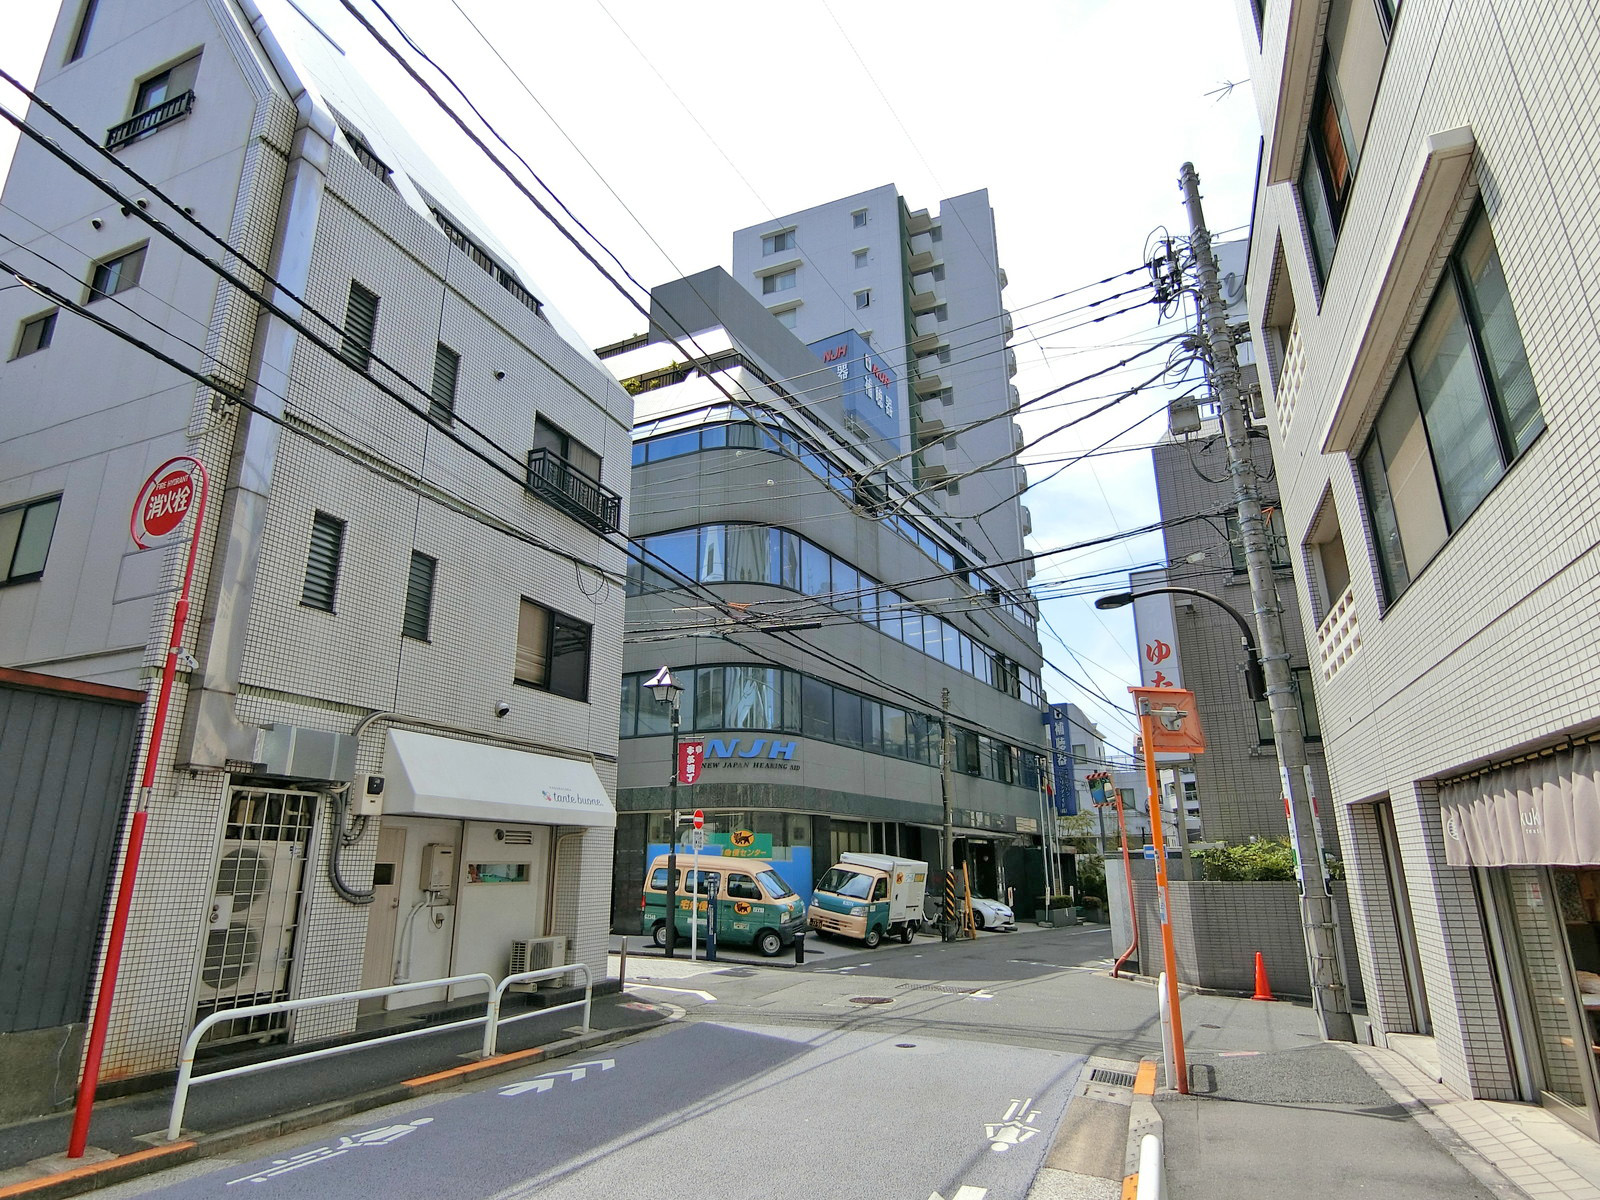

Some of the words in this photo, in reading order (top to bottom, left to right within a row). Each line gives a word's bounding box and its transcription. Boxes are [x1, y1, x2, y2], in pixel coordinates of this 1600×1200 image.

[823, 344, 848, 363] NJH
[864, 374, 893, 418] 補聴器
[156, 481, 167, 490] FIRE
[167, 475, 190, 488] HYDRANT
[146, 486, 191, 520] 消火栓
[703, 739, 797, 761] NJH
[1054, 721, 1068, 767] 補聴器
[722, 761, 749, 769] JAPAN
[753, 762, 788, 770] HEARING
[553, 792, 577, 804] tante
